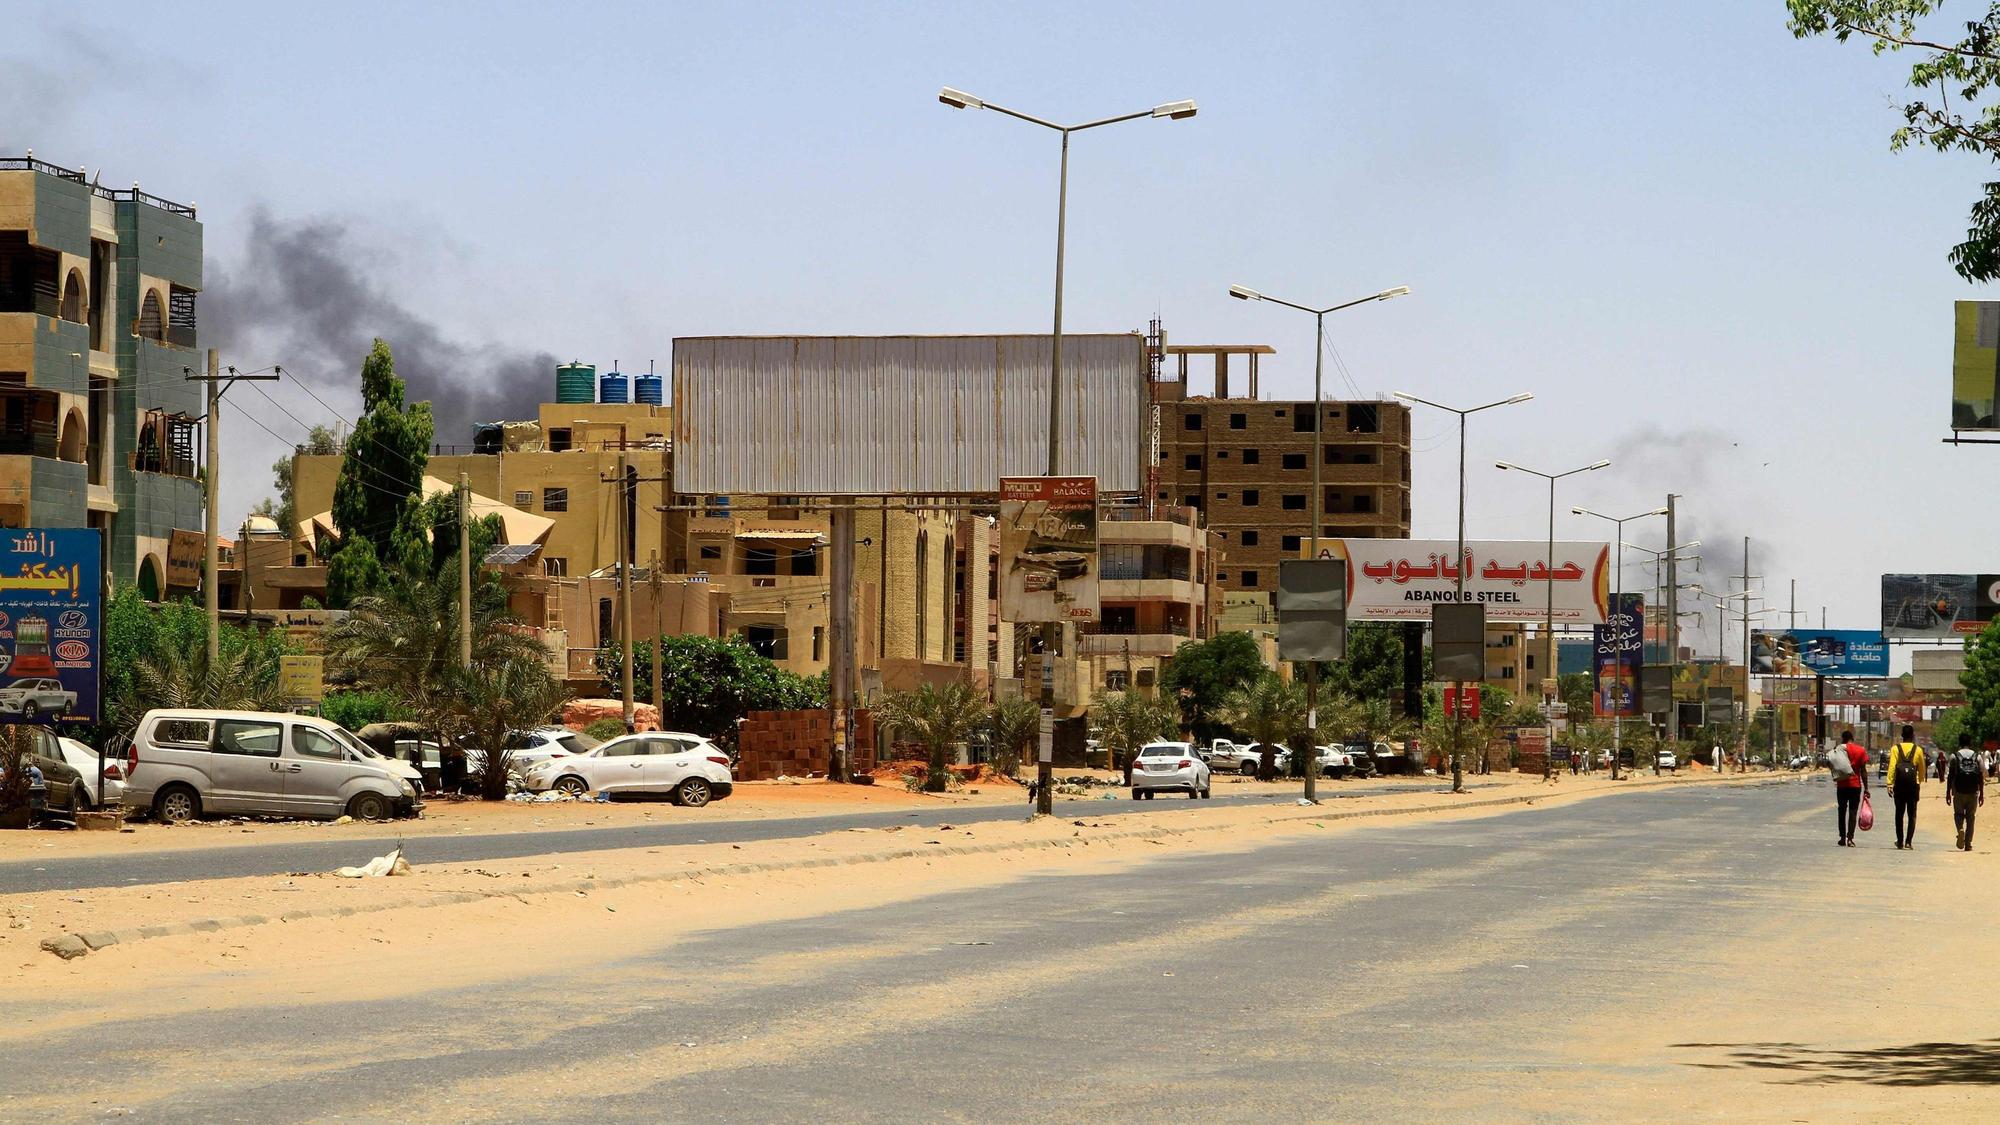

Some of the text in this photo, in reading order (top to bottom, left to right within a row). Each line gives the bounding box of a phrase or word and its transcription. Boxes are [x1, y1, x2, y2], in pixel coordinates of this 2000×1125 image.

[1053, 488, 1092, 496] BALANCE
[10, 531, 55, 557] راشد
[1362, 546, 1585, 587] حديد أبانوب
[1477, 591, 1521, 603] STEEL
[54, 629, 91, 638] HYUNDAI
[62, 645, 83, 657] KIA
[1850, 652, 1881, 664] صافية
